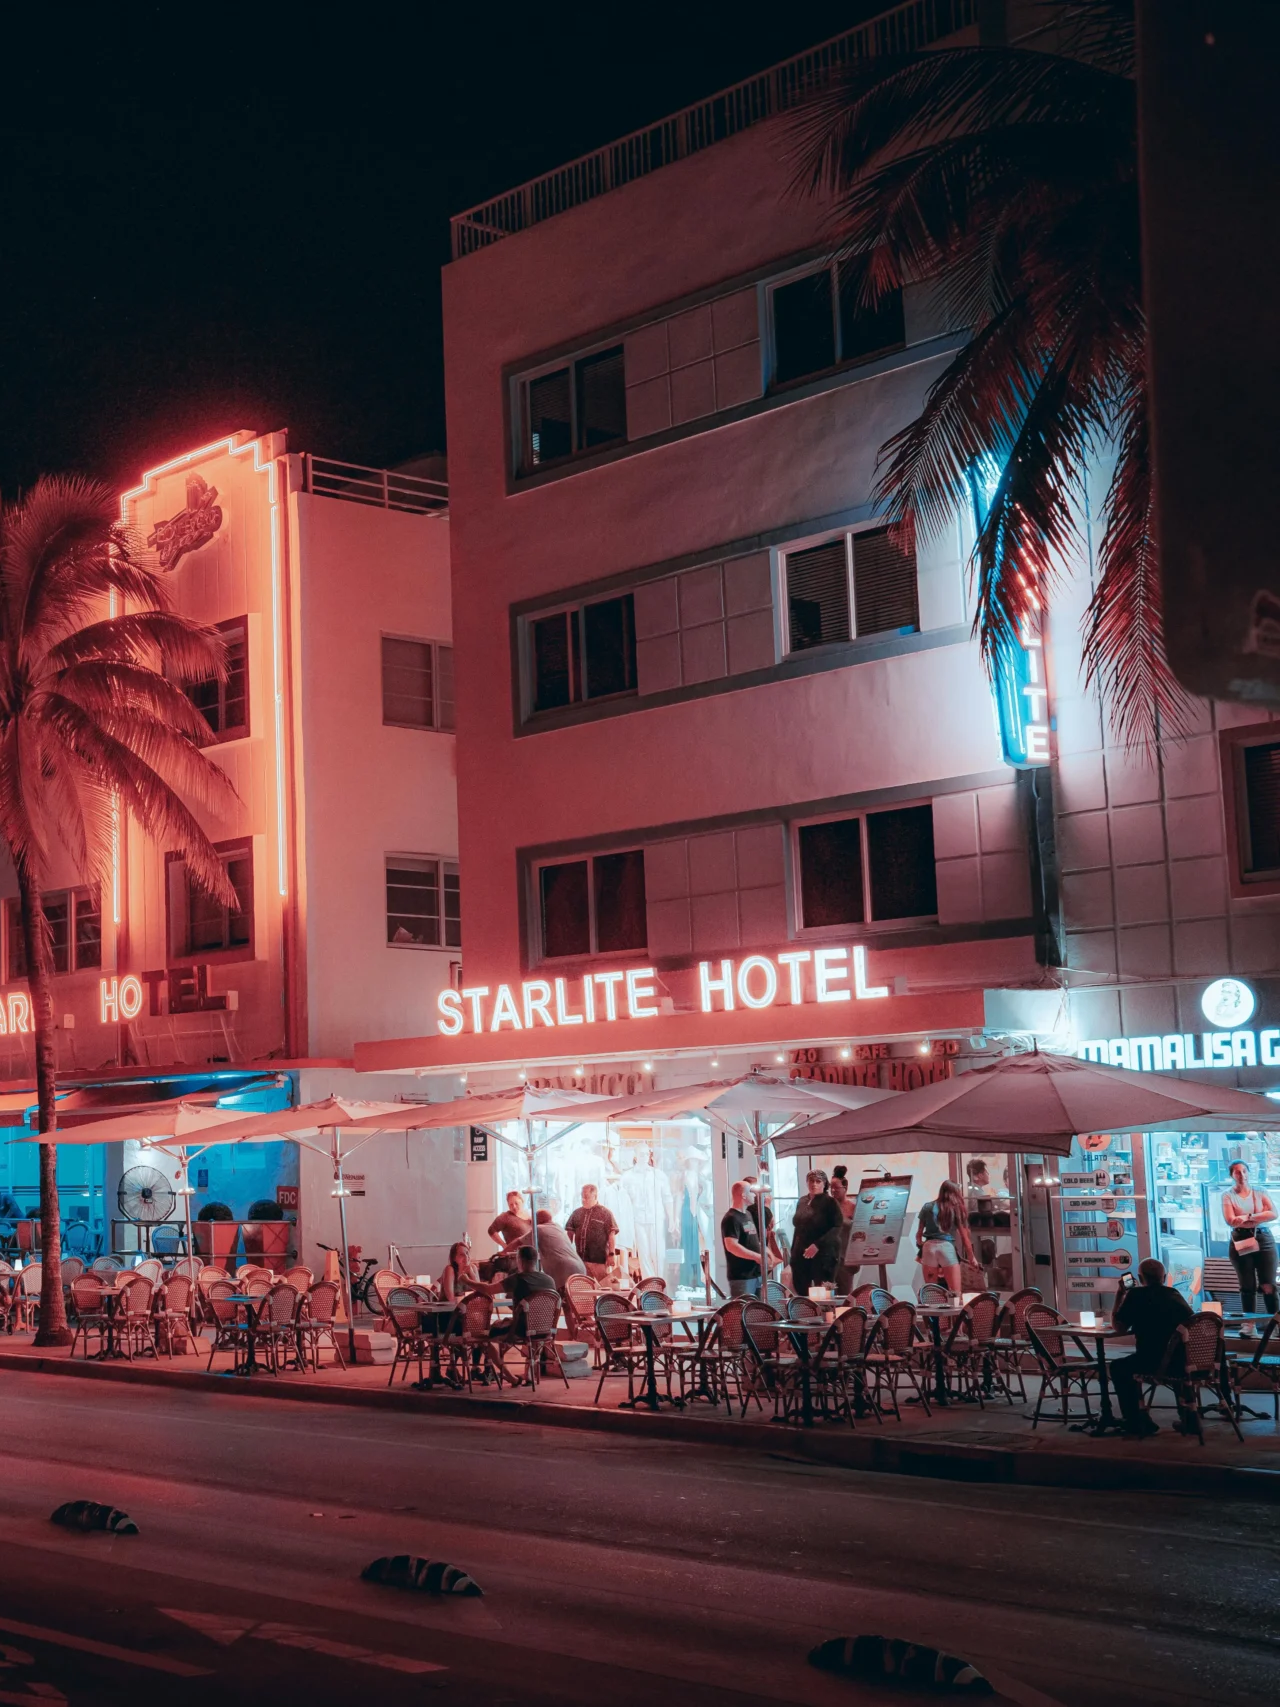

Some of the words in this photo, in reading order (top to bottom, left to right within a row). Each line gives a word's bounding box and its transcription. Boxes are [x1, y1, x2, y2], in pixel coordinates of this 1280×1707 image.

[100, 965, 229, 1024] HOTEL
[437, 966, 658, 1036] STARLITE
[698, 944, 889, 1013] HOTEL
[789, 1049, 817, 1063] 750
[854, 1043, 888, 1060] CAFE
[1077, 1030, 1257, 1072] MAMALISA
[1083, 1154, 1108, 1162] GELATO
[279, 1191, 296, 1204] FDC
